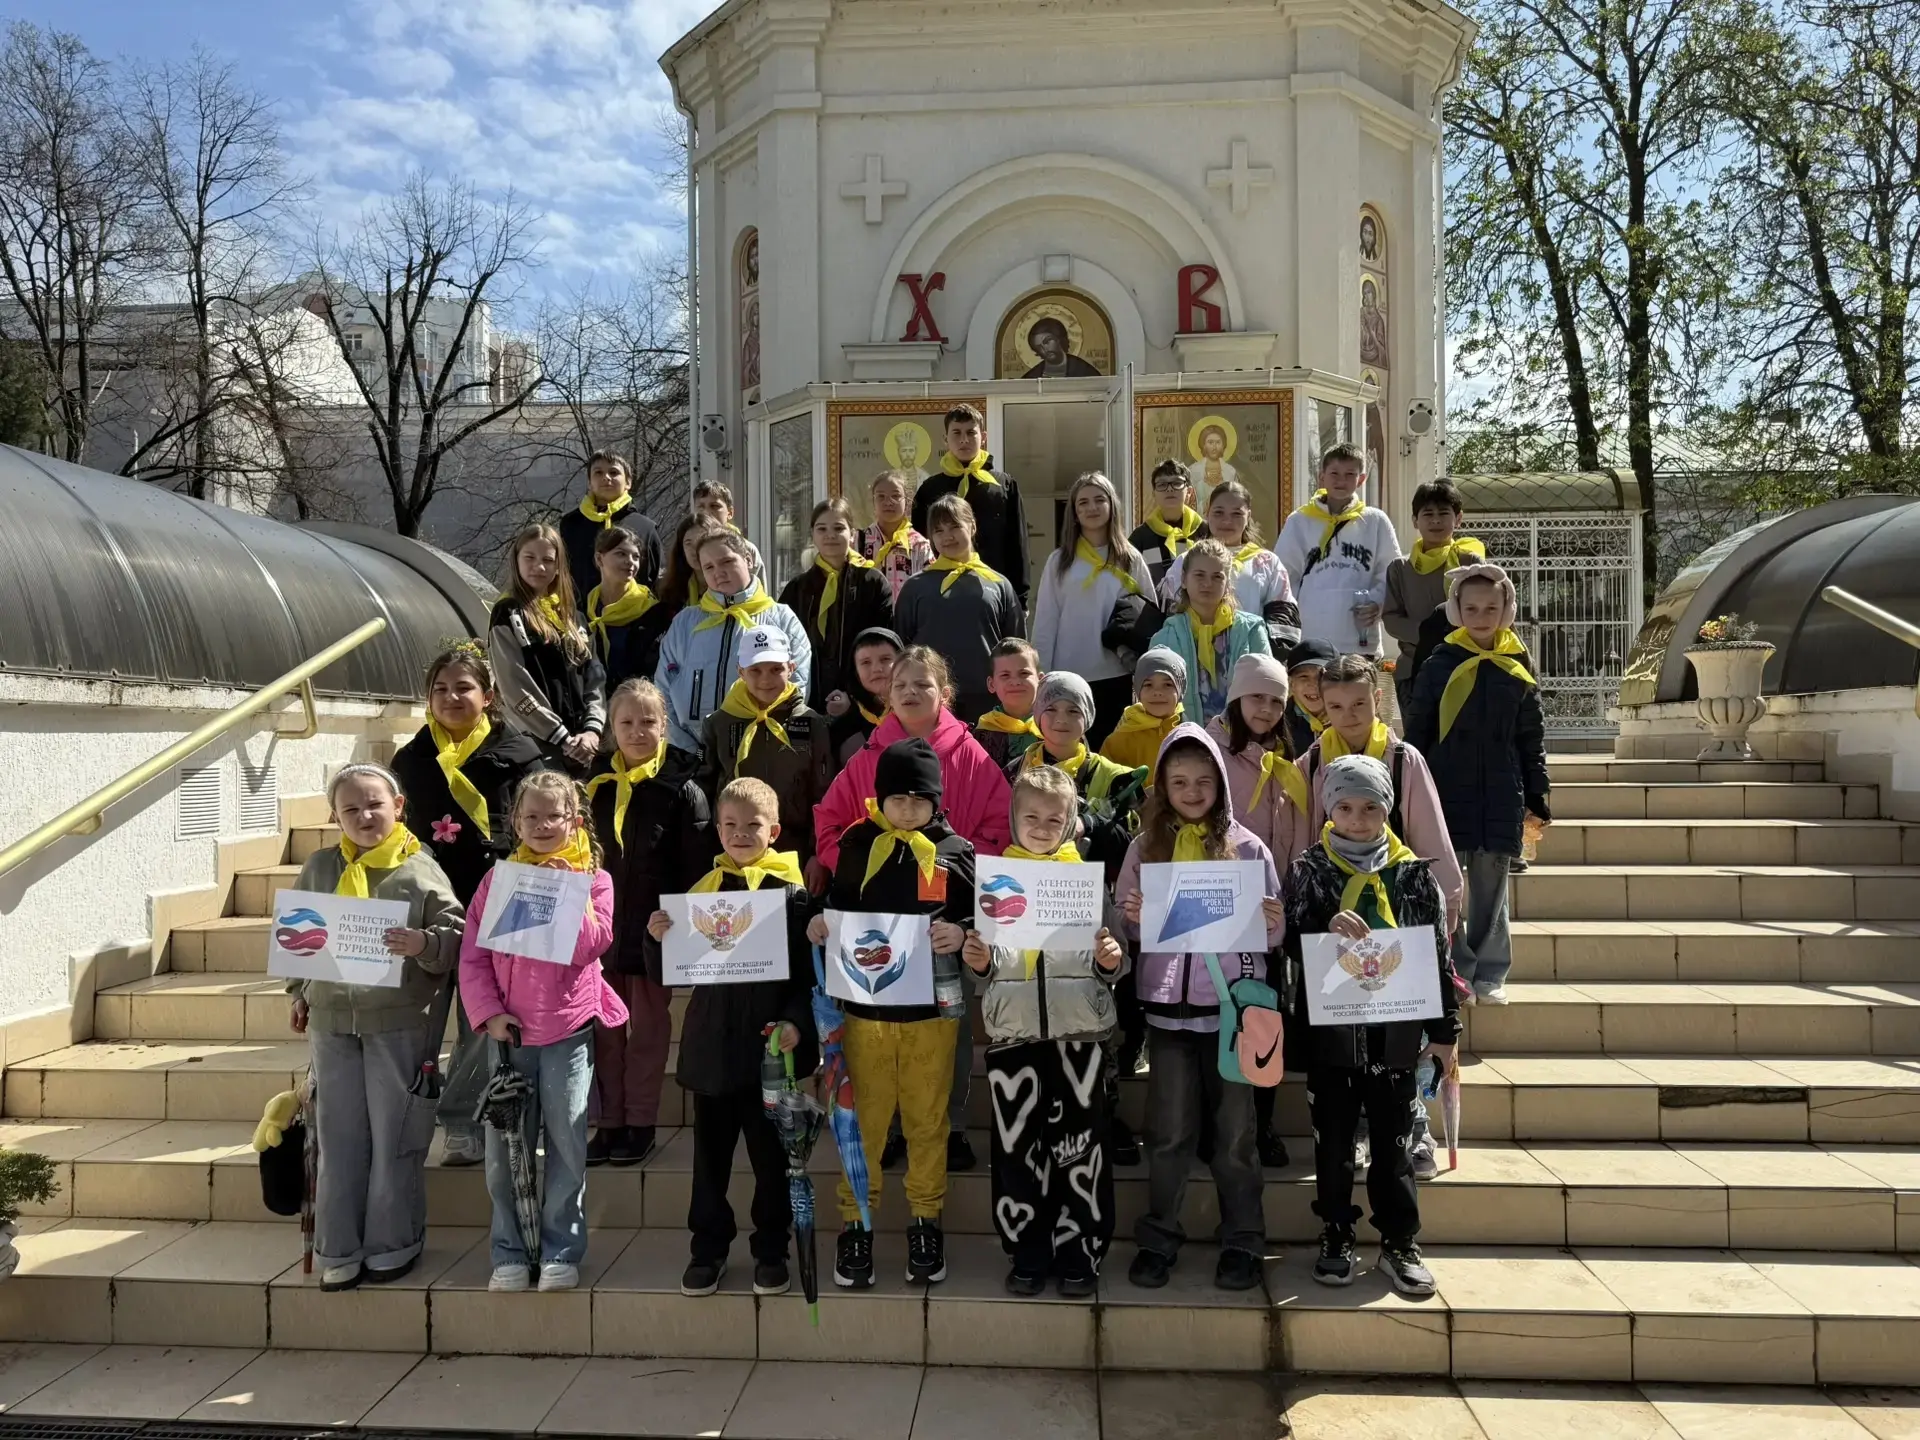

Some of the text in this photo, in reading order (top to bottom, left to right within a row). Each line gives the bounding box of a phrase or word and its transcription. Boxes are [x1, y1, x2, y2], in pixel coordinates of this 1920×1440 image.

[1036, 879, 1095, 888] АГЕНТСТВО
[514, 892, 556, 906] НАЦИОНАЛЬНЫЕ
[1036, 889, 1094, 899] РАЗВИТИЯ
[1180, 890, 1232, 899] НАЦИОНАЛЬНЫЕ
[1036, 899, 1094, 908] ВНУТРЕННЕГО
[1202, 898, 1232, 907] ПРОЕКТЫ
[528, 902, 554, 915] ПРОЕКТЫ
[1208, 906, 1232, 914] РОССИИ
[530, 911, 552, 921] РОССИИ
[1036, 909, 1093, 919] ТУРИЗМА
[339, 913, 398, 926] АГЕНТСТВО
[676, 960, 773, 971] МИНИСТЕРСТВО ПРОСВЕЩЕНИЯ
[684, 967, 765, 977] РОССИЙСКОЙ ФЕДЕРАЦИИ
[1322, 998, 1426, 1011] МИНИСТЕРСТВО ПРОСВЕЩЕНИЯ
[1332, 1006, 1418, 1017] РОССИЙСКОЙ ФЕДЕРАЦИИ
